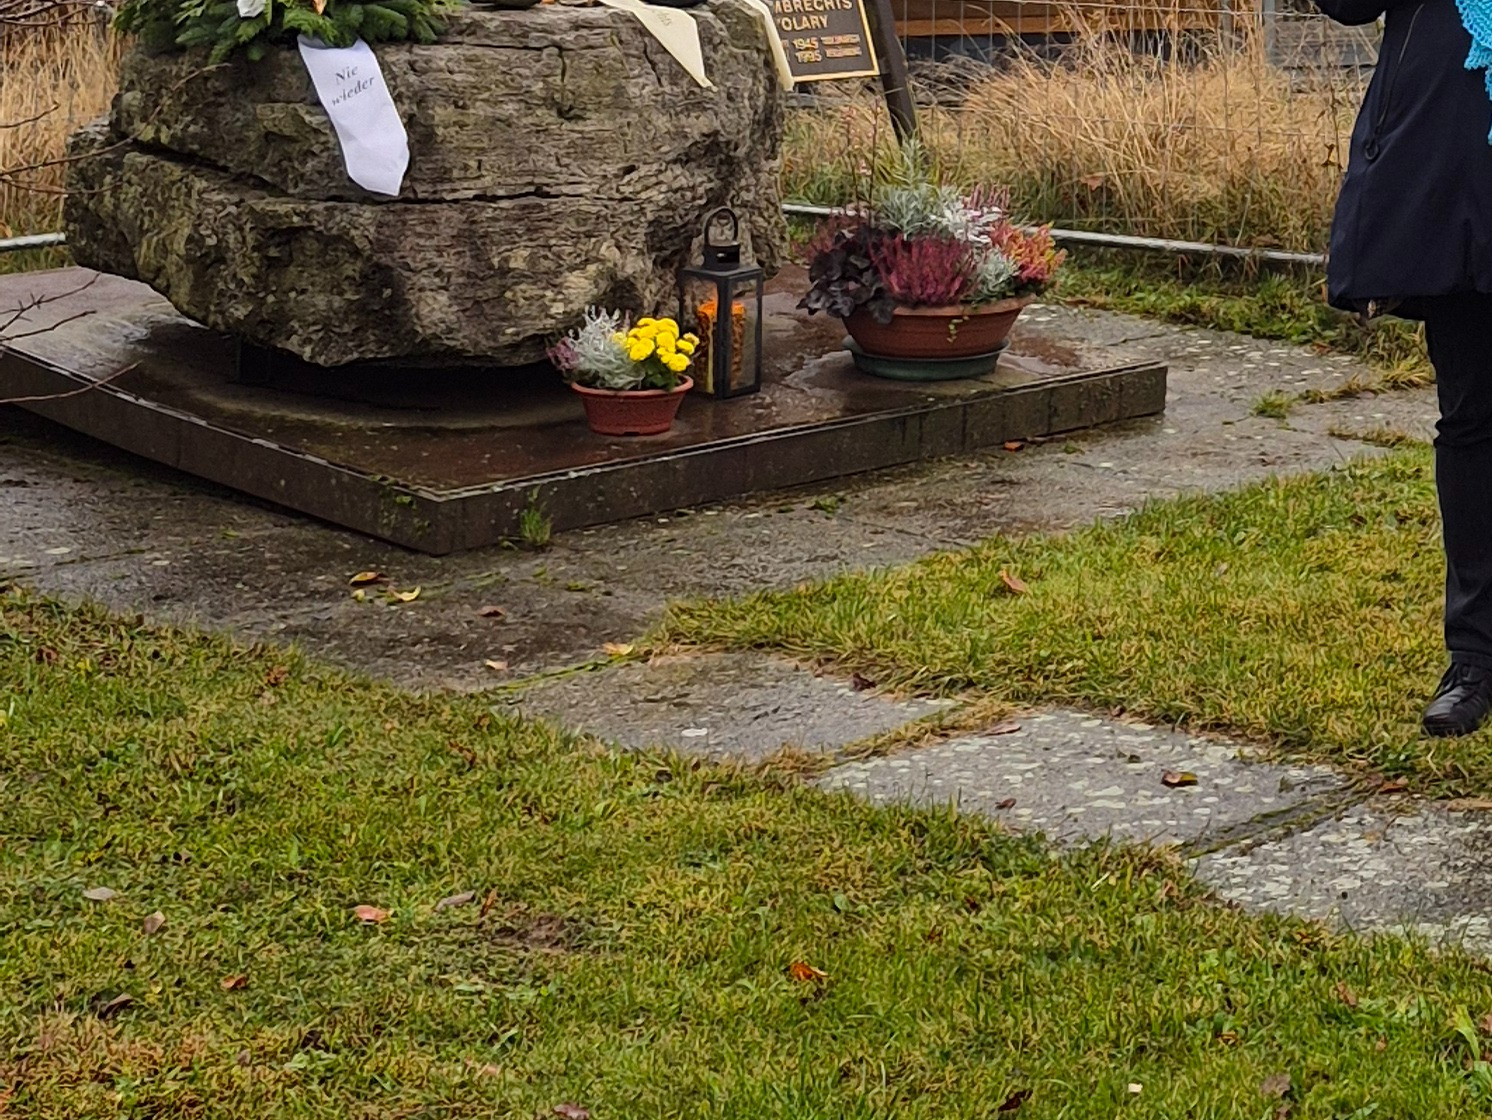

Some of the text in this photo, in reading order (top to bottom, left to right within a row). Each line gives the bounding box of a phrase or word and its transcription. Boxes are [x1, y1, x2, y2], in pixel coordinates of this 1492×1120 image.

[777, 14, 829, 31] OLARY
[335, 65, 359, 84] Nie
[331, 76, 376, 107] wieder
